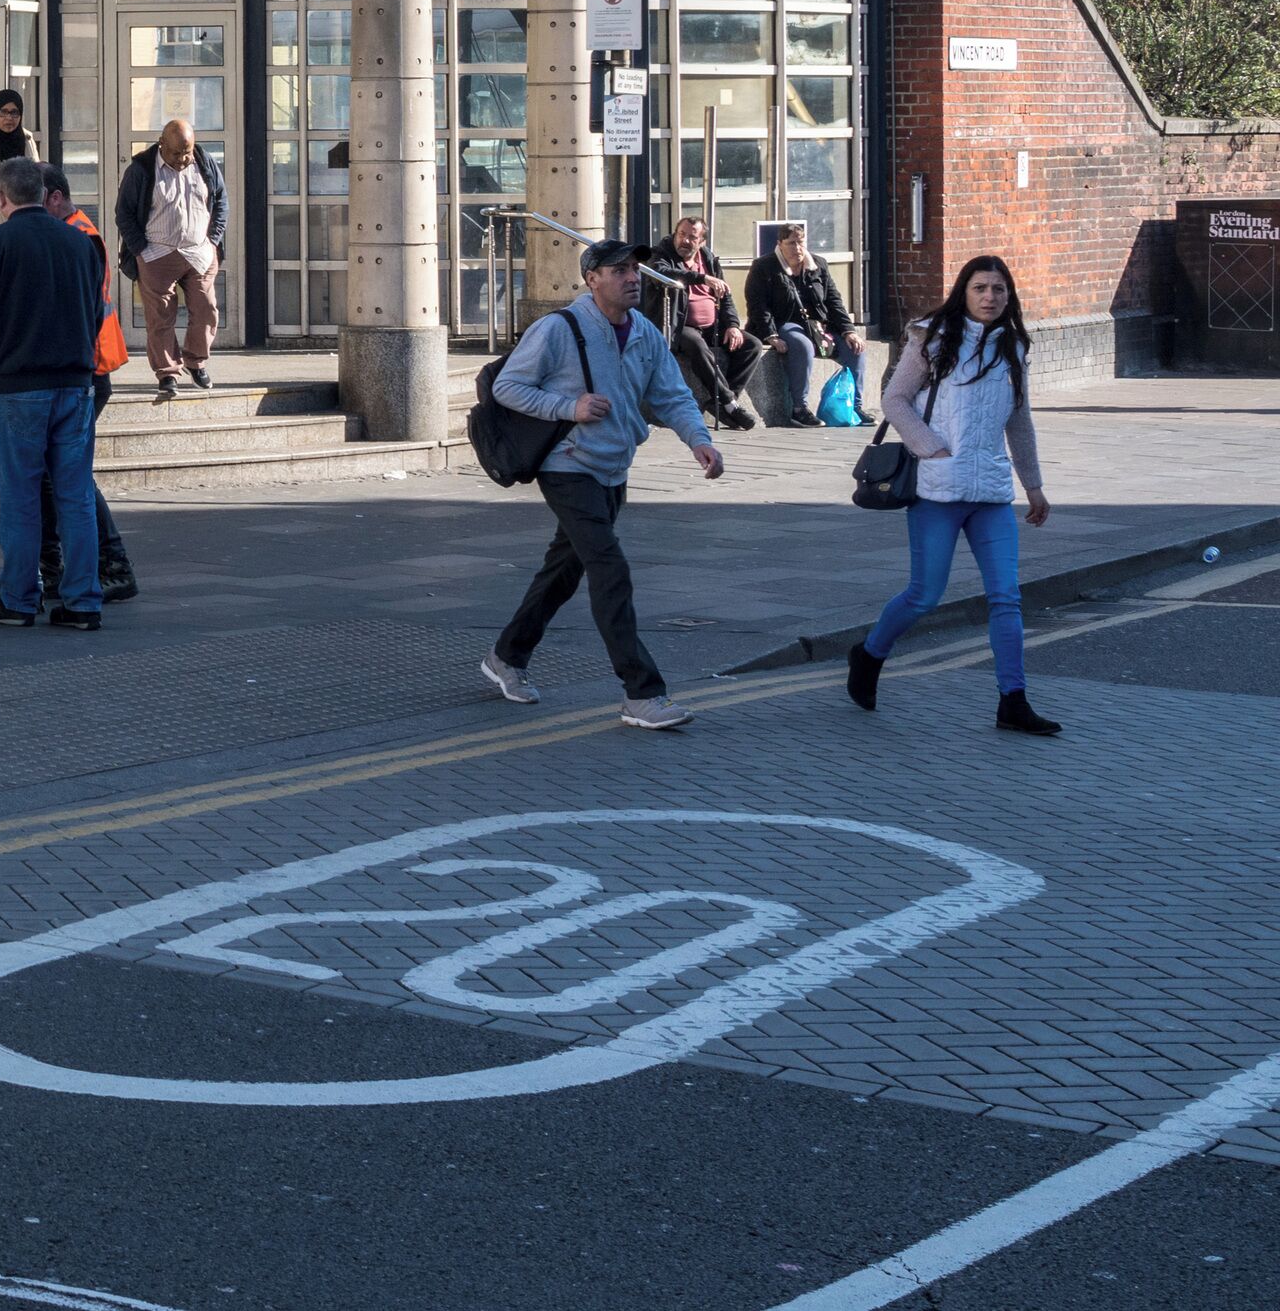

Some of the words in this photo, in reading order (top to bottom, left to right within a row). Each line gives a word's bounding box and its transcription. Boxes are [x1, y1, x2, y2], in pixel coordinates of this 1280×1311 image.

[952, 46, 984, 61] VINCENT
[986, 46, 1005, 61] ROAD
[1209, 213, 1272, 230] Evening
[1208, 225, 1280, 240] Standard
[156, 856, 804, 1015] 20
